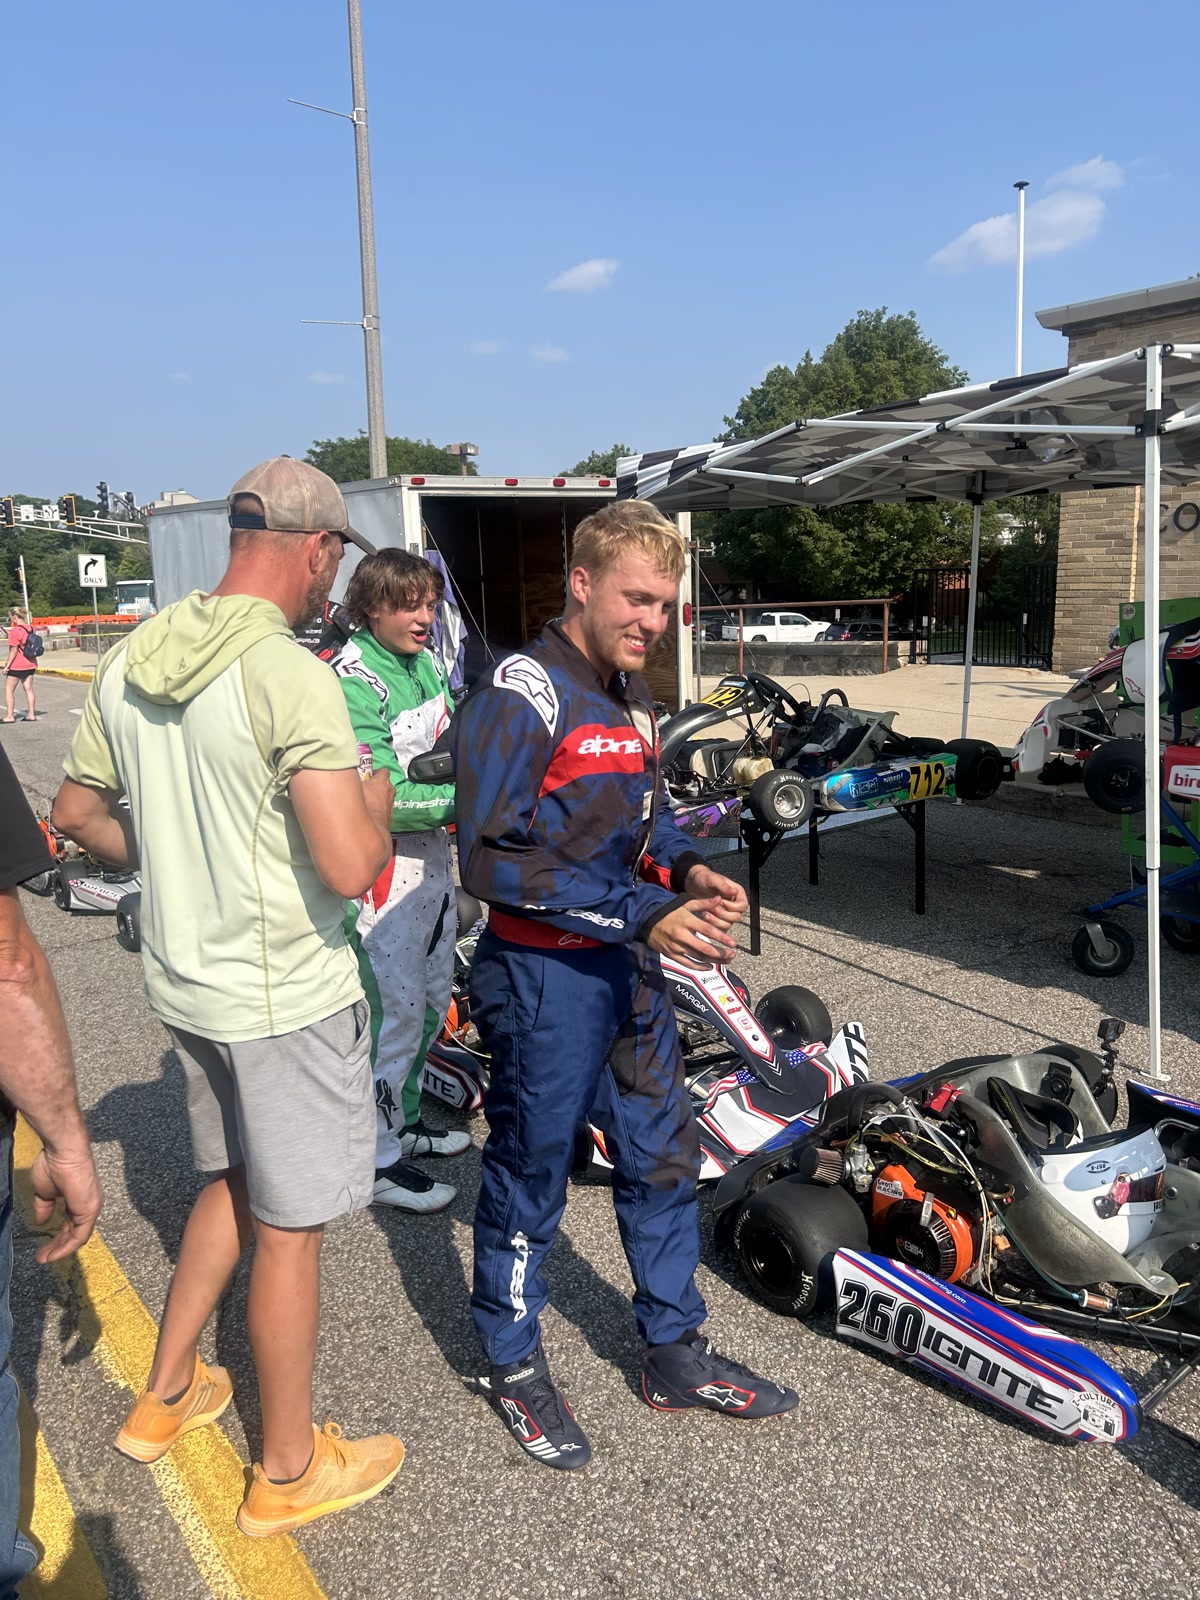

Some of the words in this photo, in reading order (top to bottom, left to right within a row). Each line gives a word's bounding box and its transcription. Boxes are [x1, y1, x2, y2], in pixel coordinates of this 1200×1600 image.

[910, 763, 945, 797] 712
[675, 985, 709, 1013] MARGAY
[877, 1185, 903, 1197] RACING
[791, 1270, 814, 1310] Hoosier
[836, 1279, 925, 1355] 260
[922, 1327, 1064, 1420] IGNITE
[1072, 1393, 1118, 1409] Z-CULTURE
